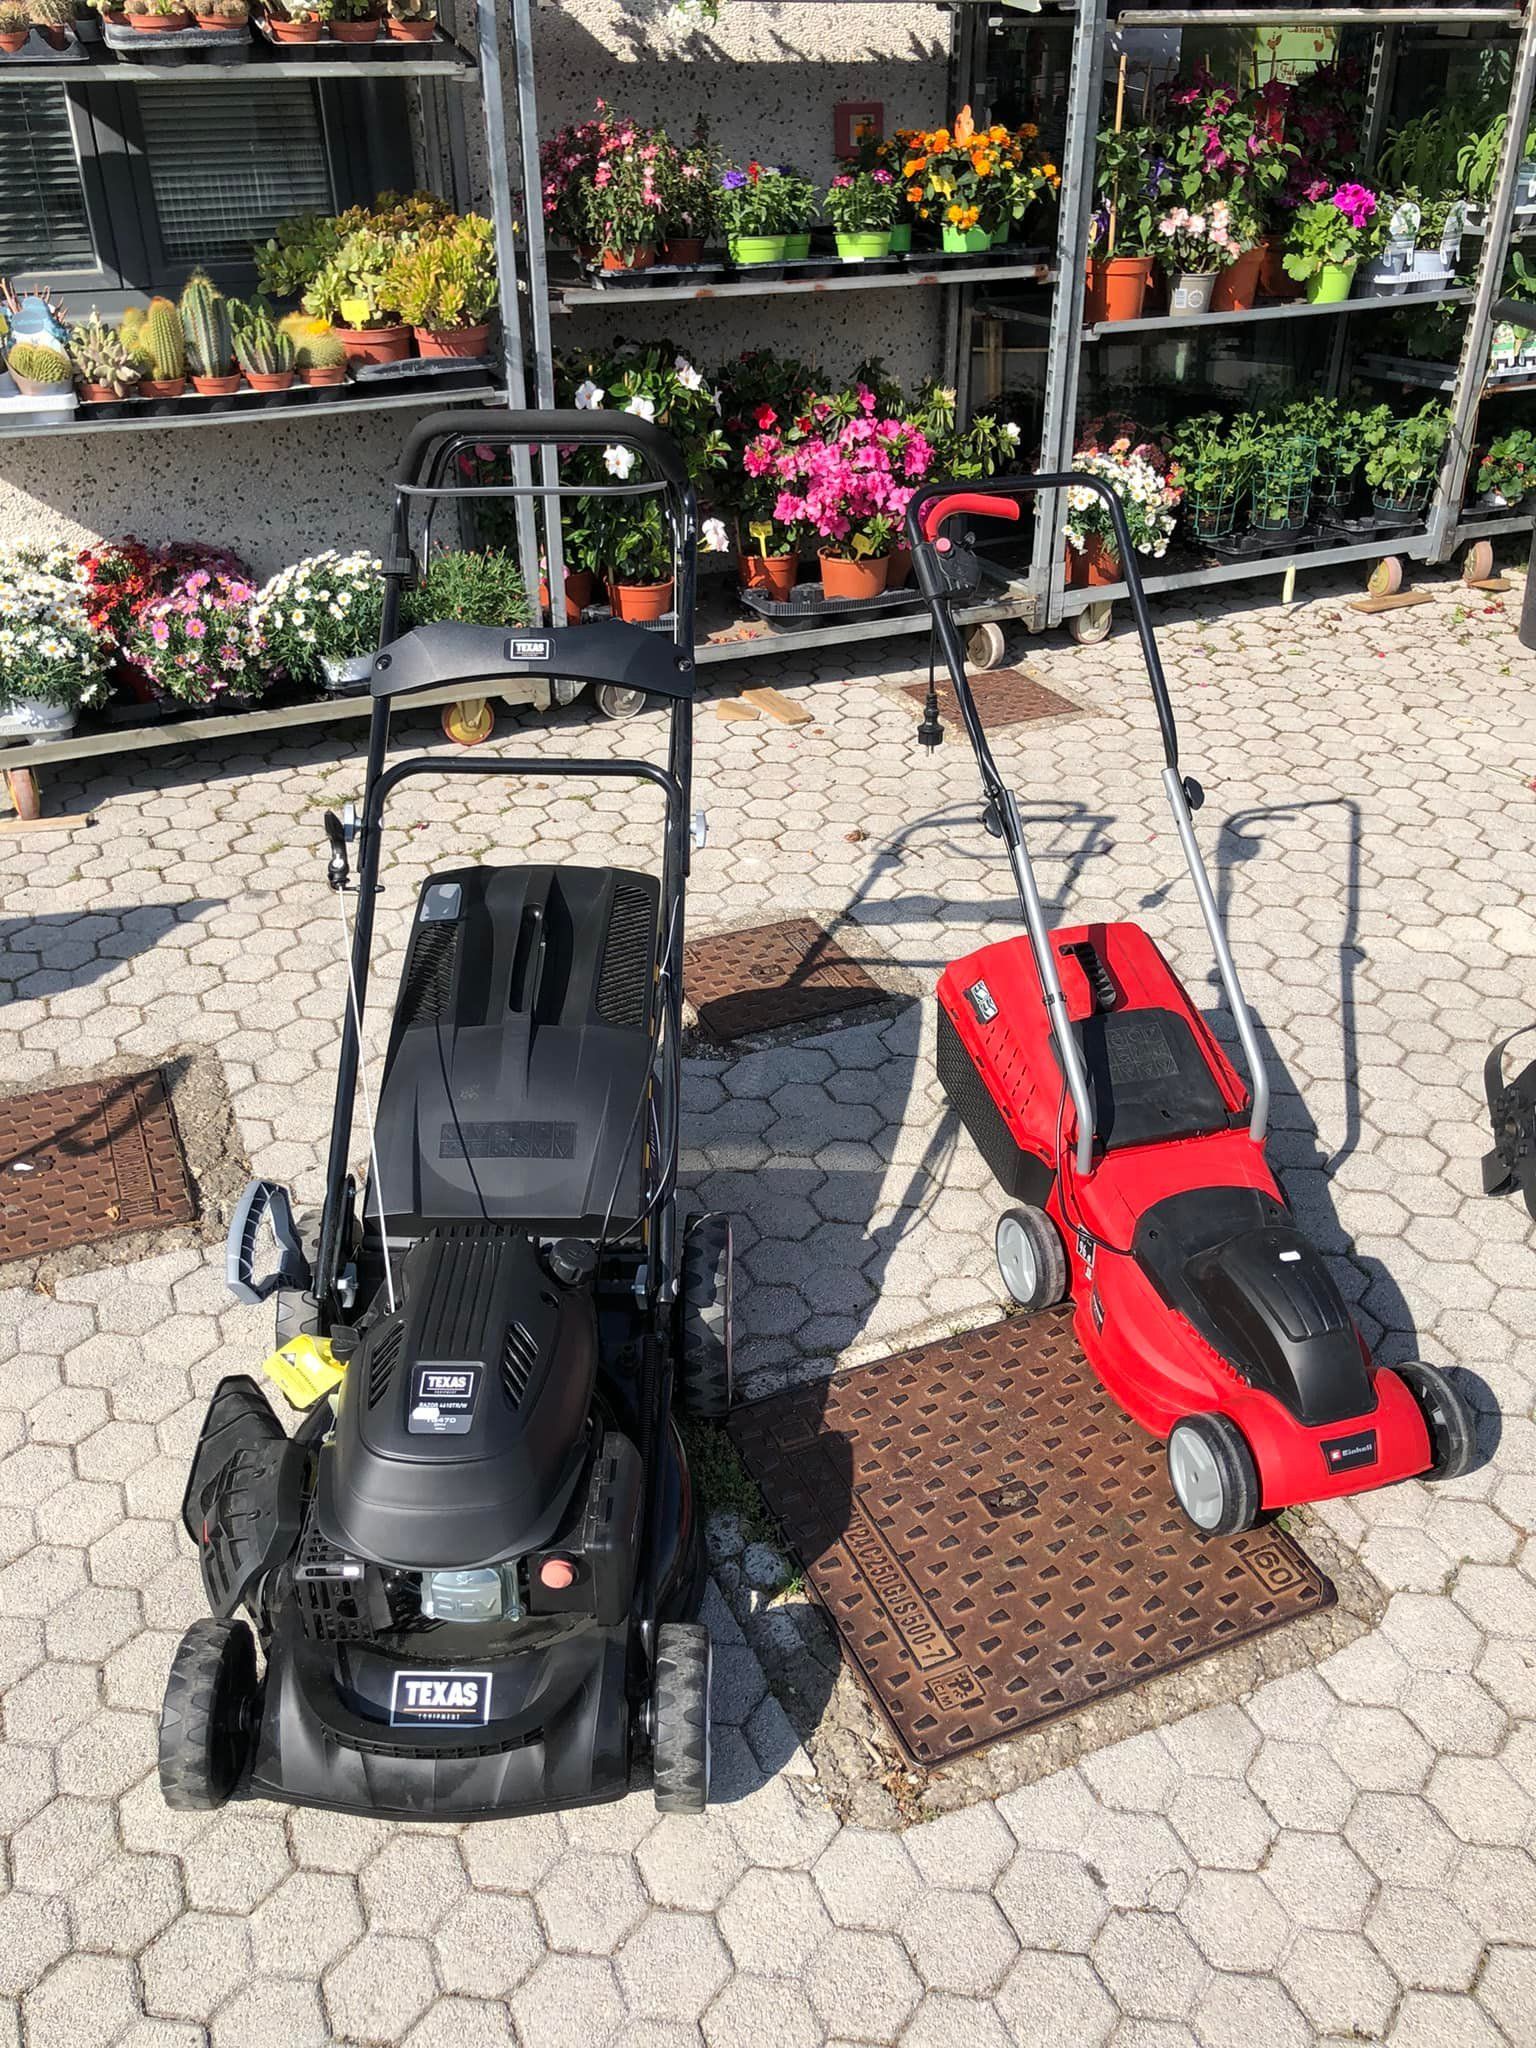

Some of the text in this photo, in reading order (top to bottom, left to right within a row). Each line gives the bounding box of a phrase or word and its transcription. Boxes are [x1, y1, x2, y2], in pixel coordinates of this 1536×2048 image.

[515, 642, 545, 652] TEXAS
[428, 1376, 467, 1388] TEXAS
[1341, 1443, 1373, 1457] Einhell
[1254, 1551, 1294, 1585] 60
[405, 1680, 479, 1707] TEXAS
